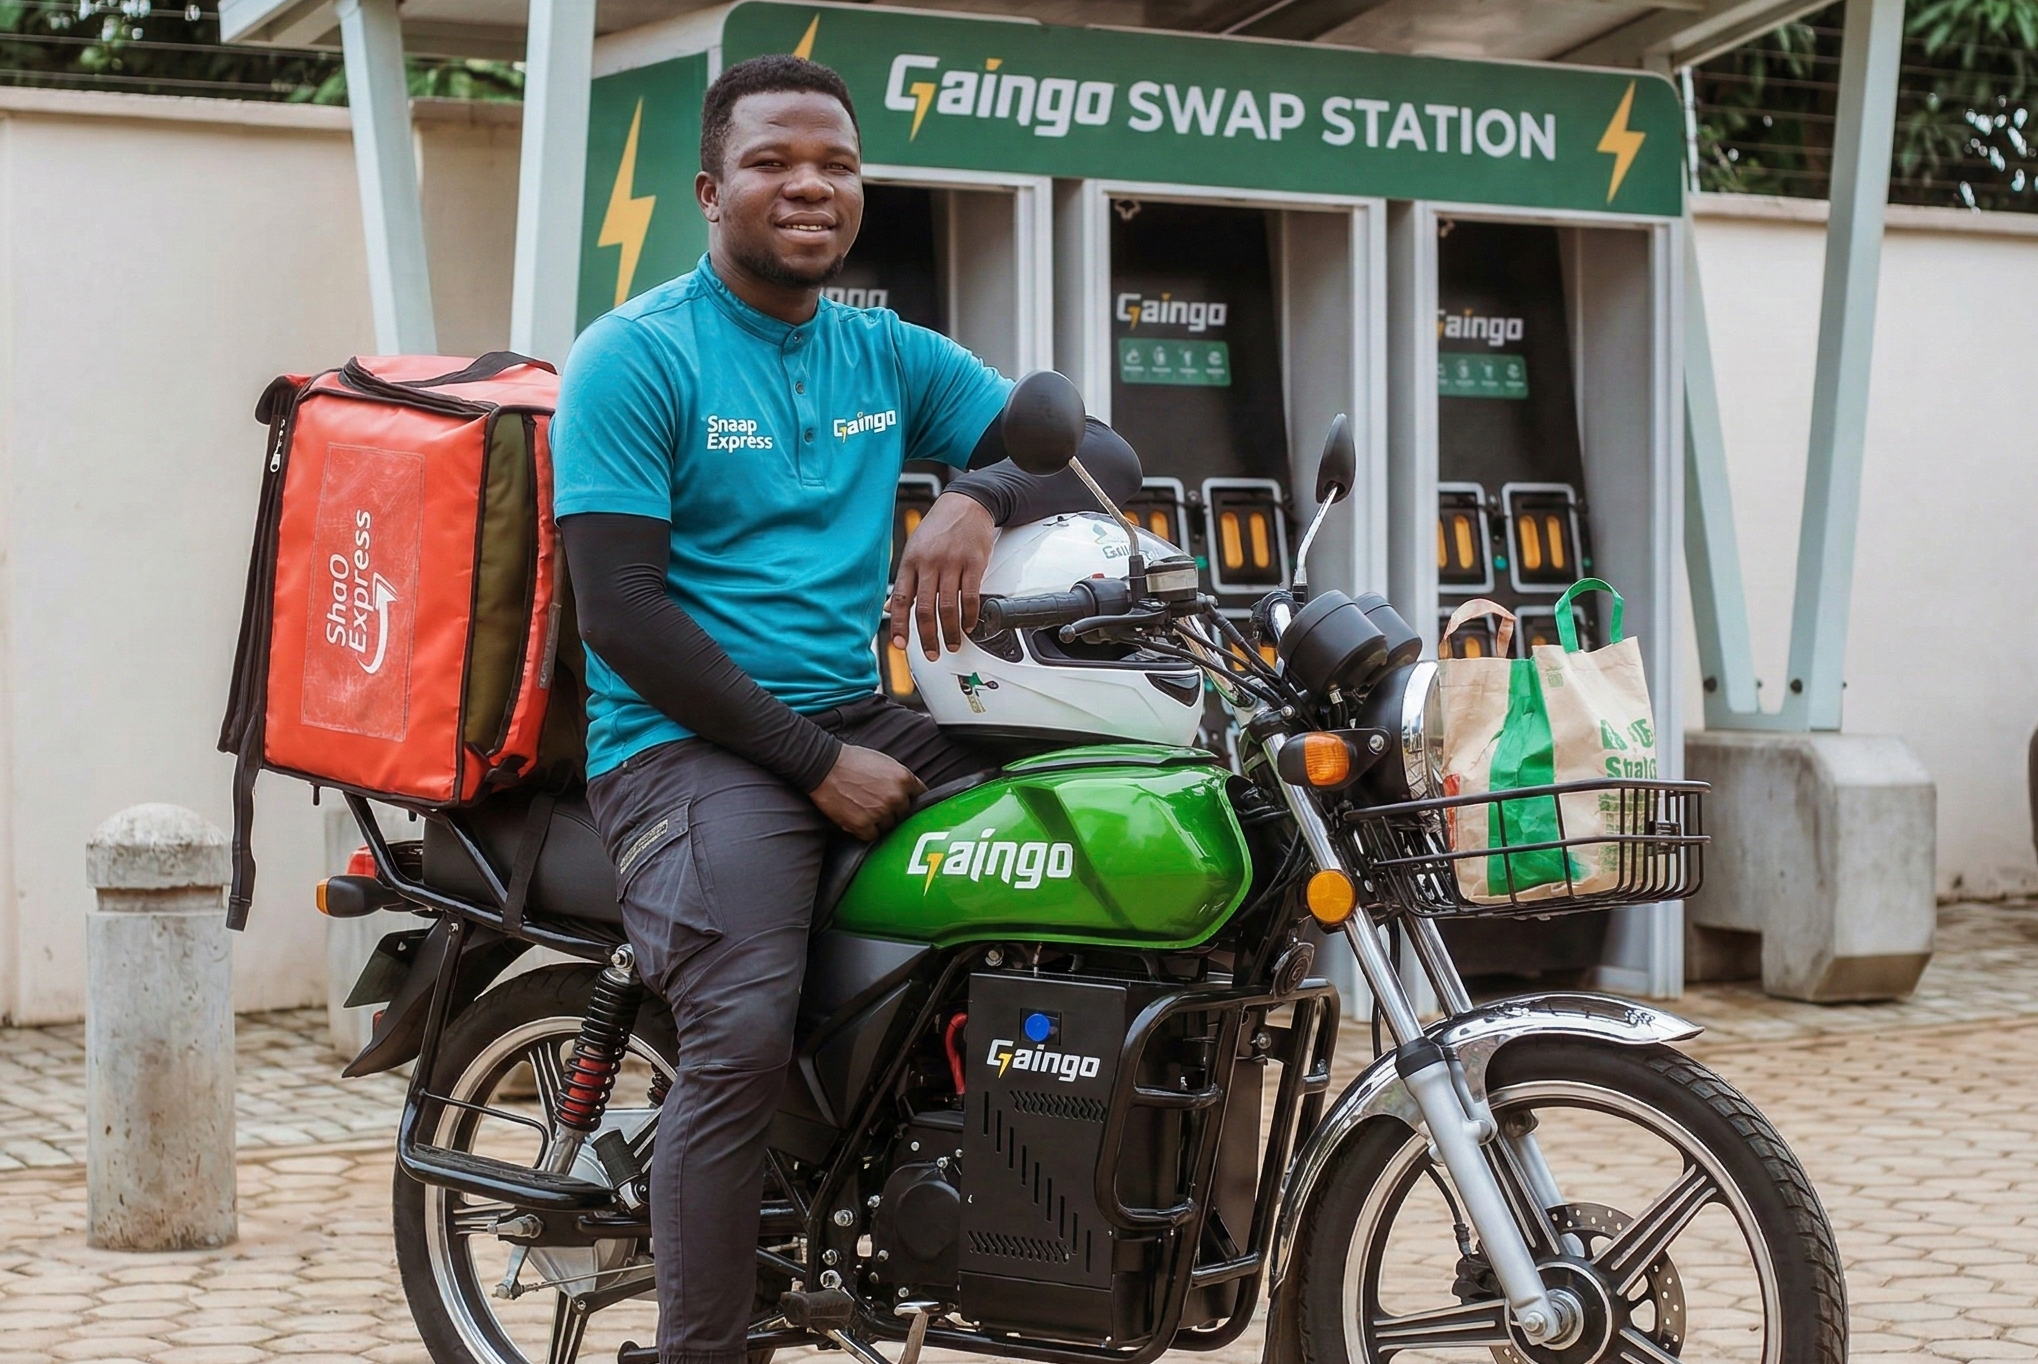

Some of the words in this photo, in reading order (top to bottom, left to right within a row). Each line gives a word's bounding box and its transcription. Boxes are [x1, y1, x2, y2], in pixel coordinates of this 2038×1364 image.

[885, 54, 1115, 142] Gaingo
[1128, 81, 1306, 141] SWAP
[1321, 97, 1556, 161] STATION
[1116, 292, 1228, 332] Gaingo
[706, 433, 773, 453] Express
[707, 415, 758, 437] Snaap
[833, 410, 897, 443] Gaingo
[348, 509, 374, 654] Express
[907, 828, 1074, 897] Gaingo
[986, 1038, 1101, 1083] Gaingo
